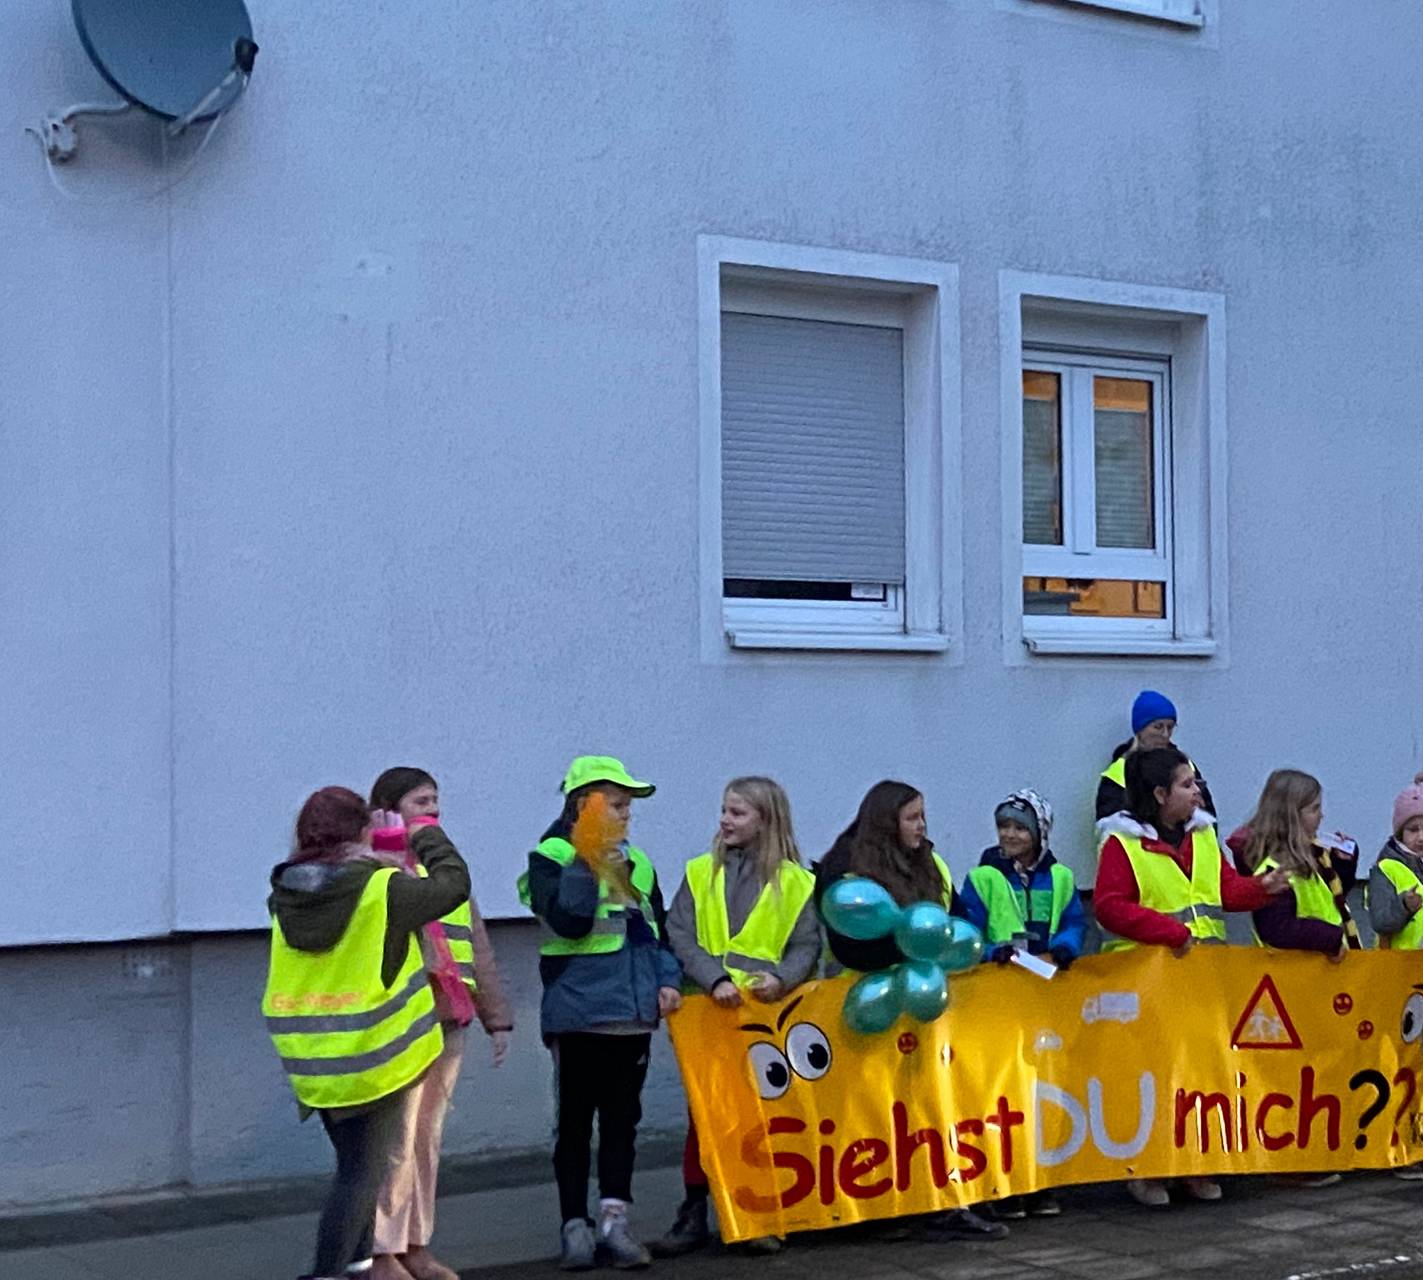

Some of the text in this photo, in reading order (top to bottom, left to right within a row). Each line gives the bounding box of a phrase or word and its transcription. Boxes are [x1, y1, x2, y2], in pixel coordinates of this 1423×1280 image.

[735, 1065, 1416, 1213] Siehst DU mich??
